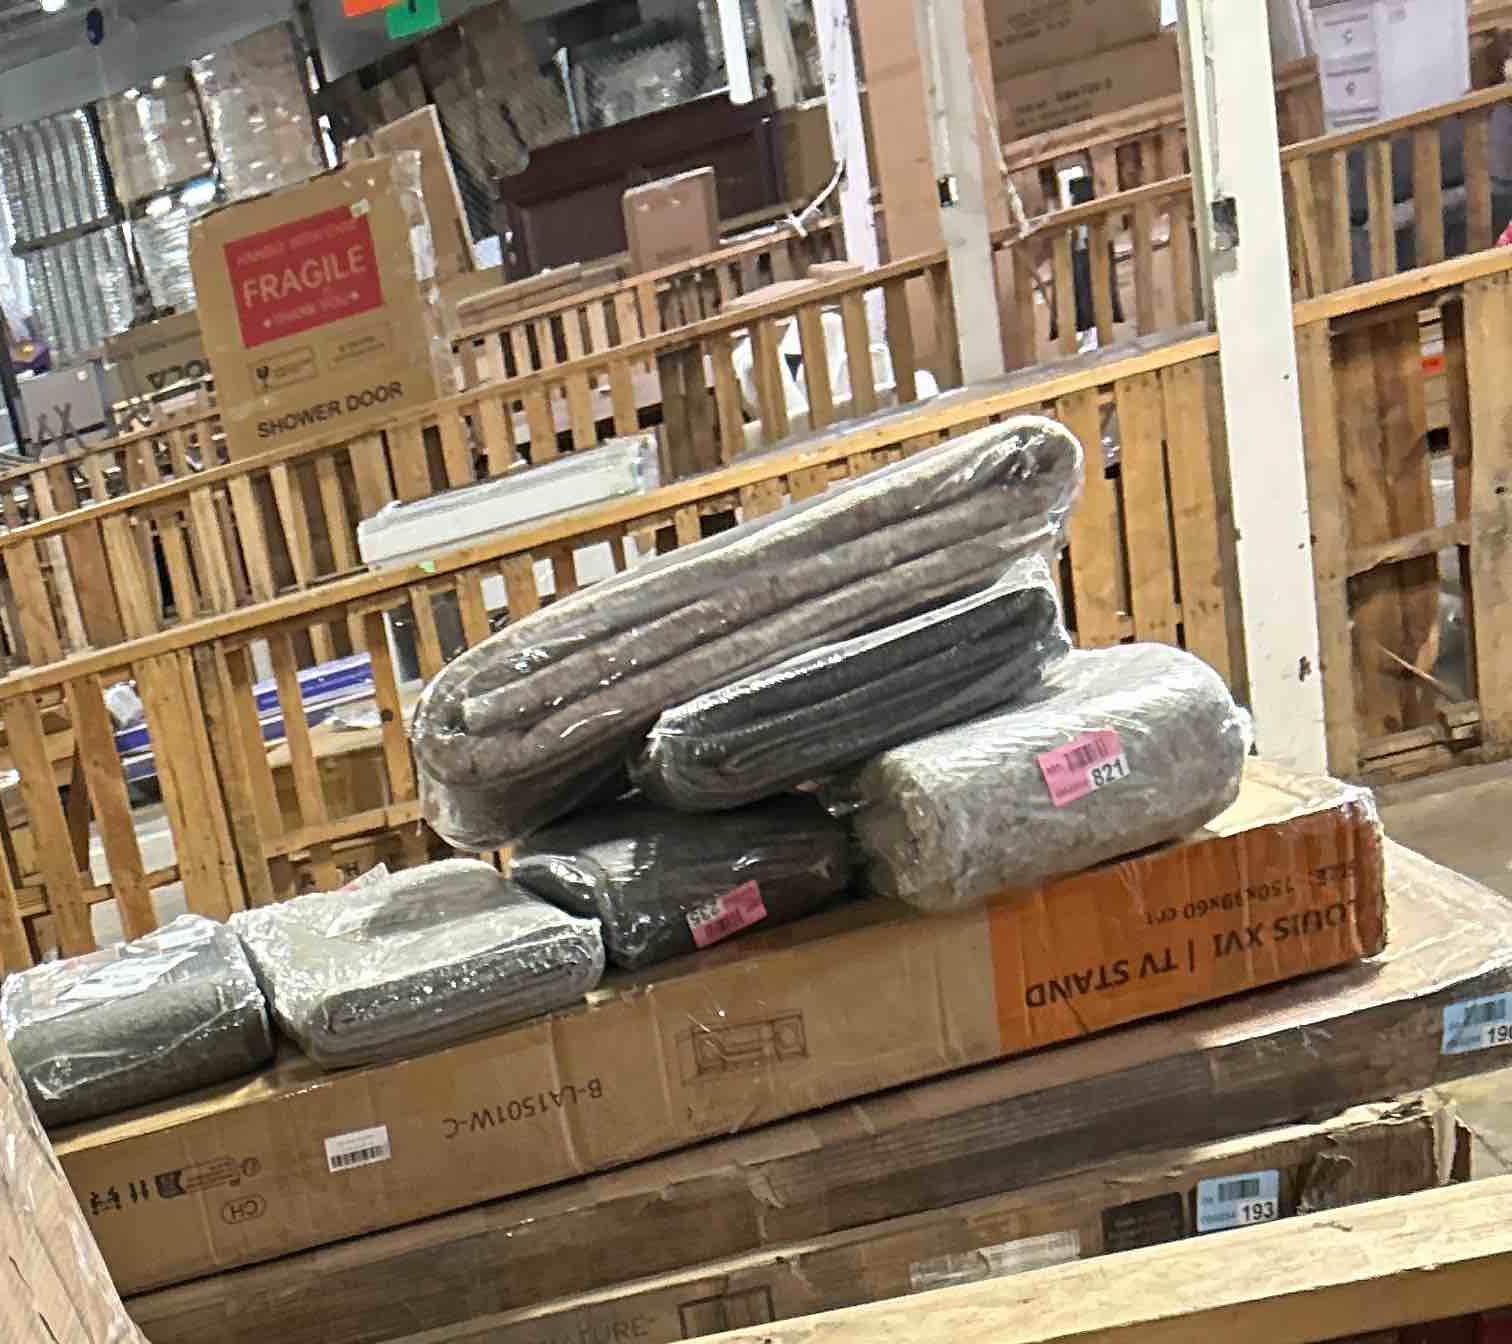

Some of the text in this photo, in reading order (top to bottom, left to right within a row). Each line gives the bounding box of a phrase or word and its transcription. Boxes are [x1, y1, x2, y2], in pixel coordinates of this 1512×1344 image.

[242, 244, 366, 308] FRAGILE
[257, 381, 404, 439] SHOWER DOOR
[1091, 757, 1126, 787] 821
[1025, 899, 1356, 1009] OUIS XVI TV STAND
[1240, 1200, 1276, 1222] 193
